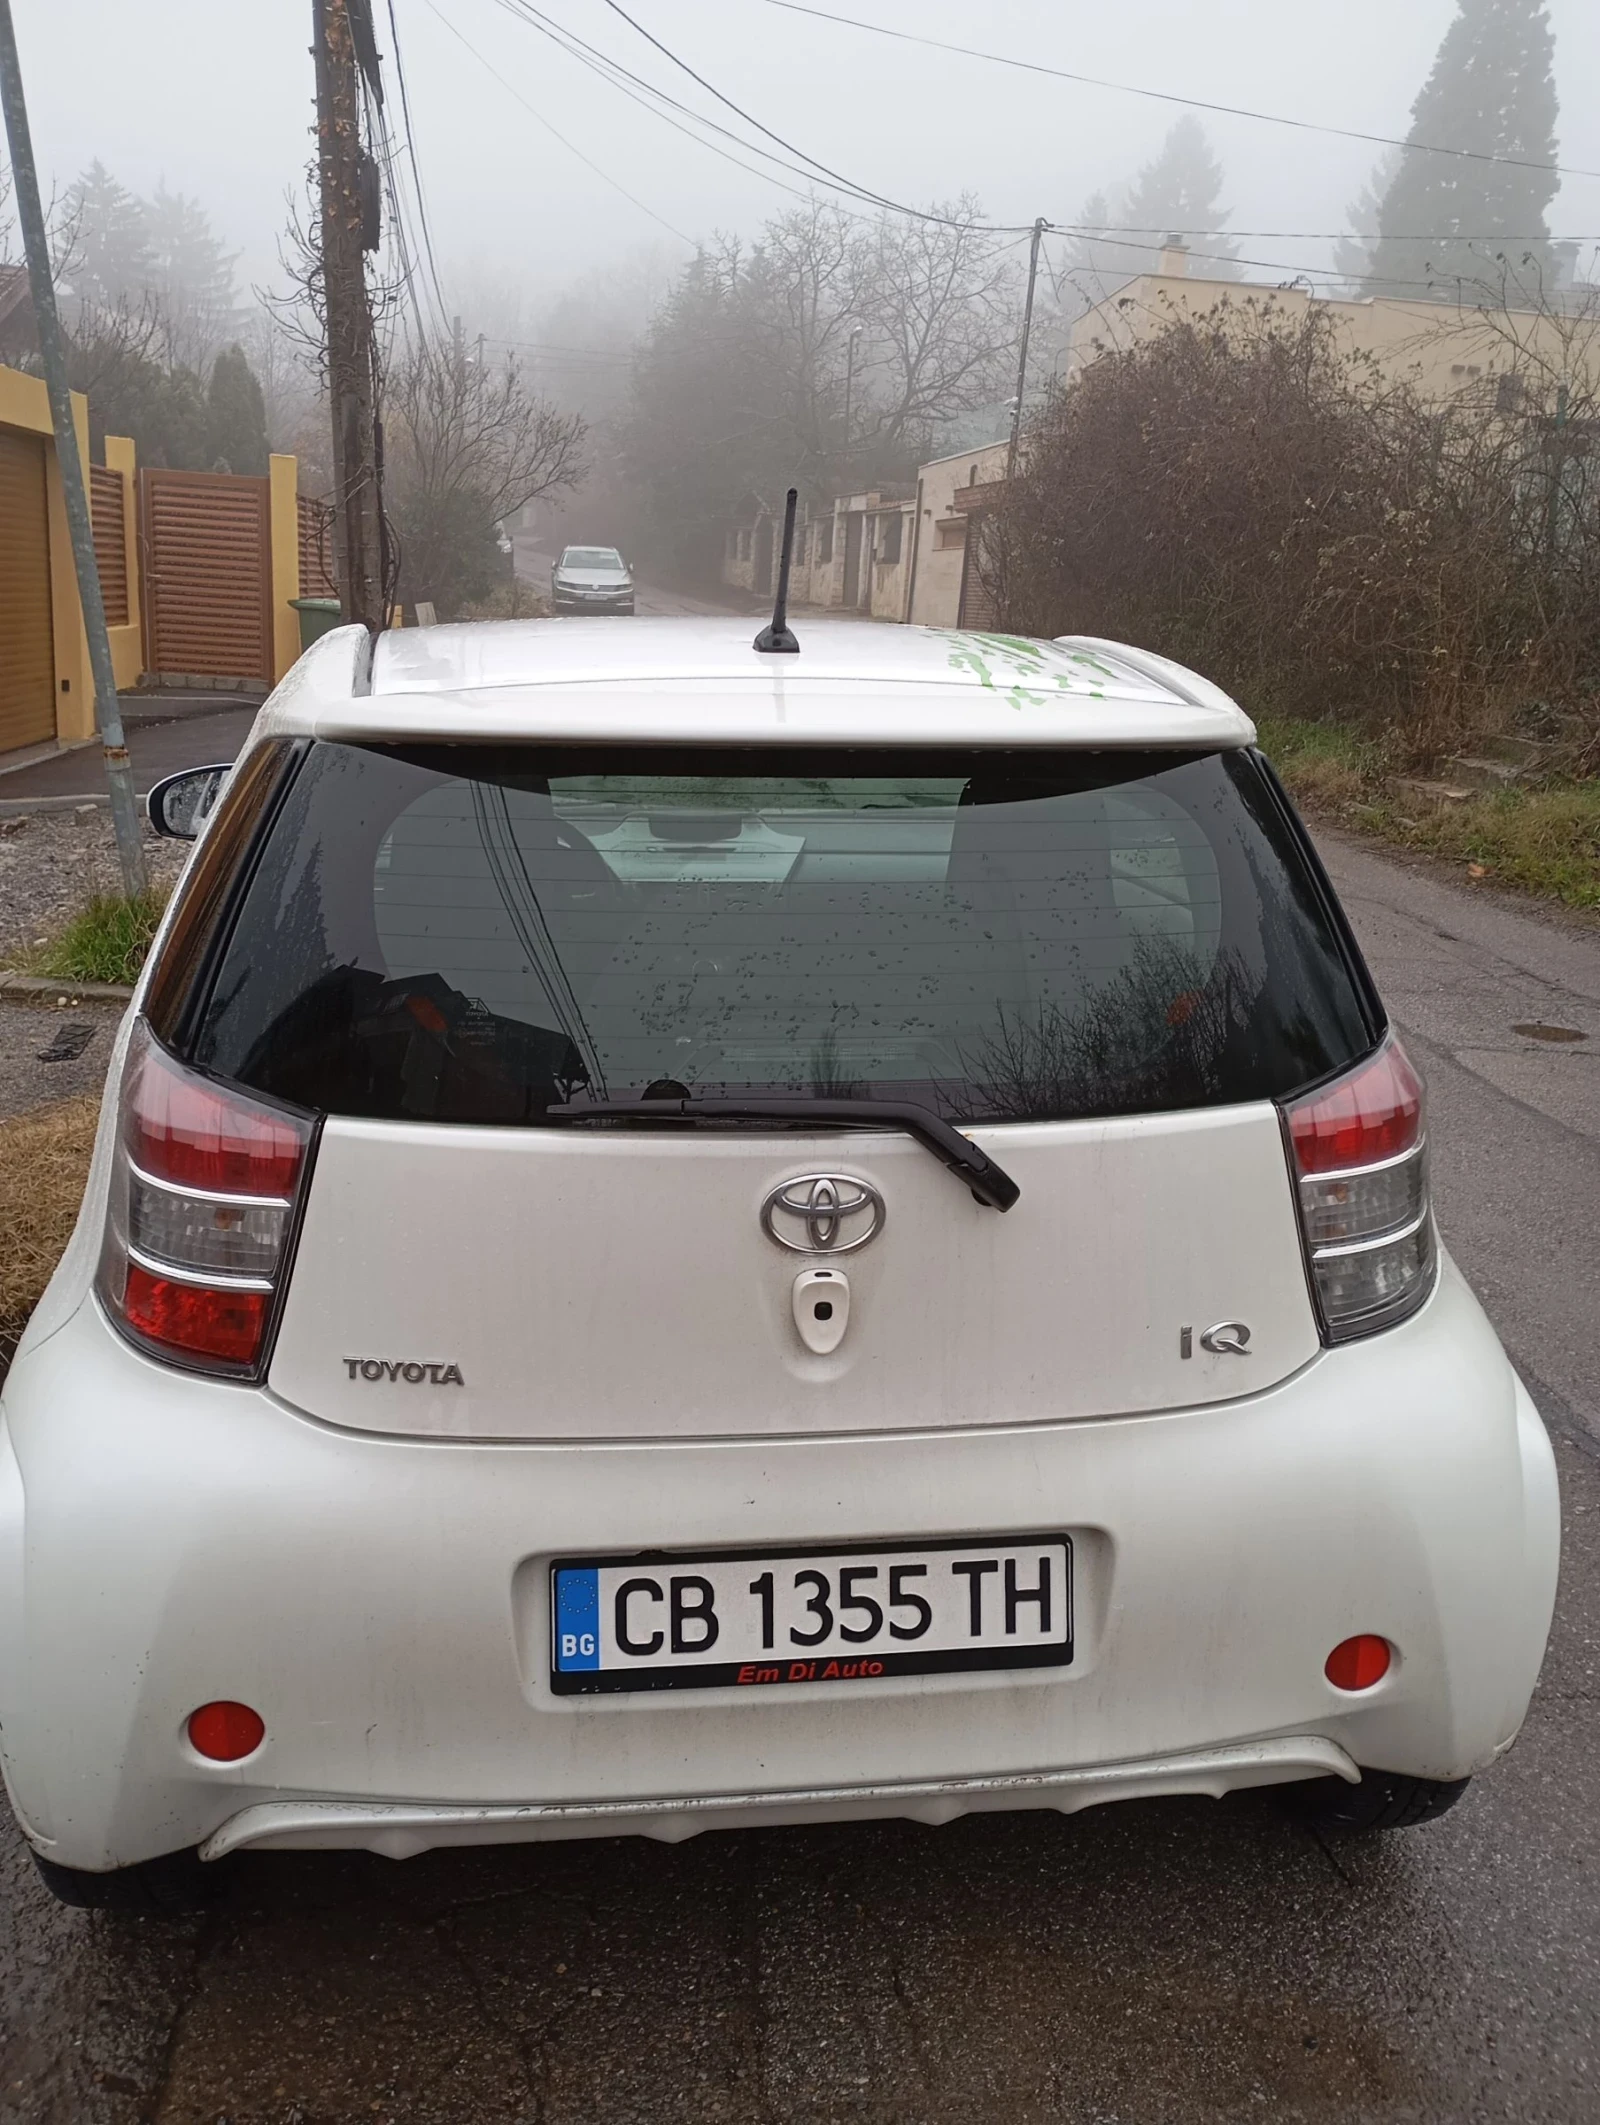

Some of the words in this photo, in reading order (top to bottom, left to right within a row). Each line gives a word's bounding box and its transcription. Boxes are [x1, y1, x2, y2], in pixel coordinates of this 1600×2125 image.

[343, 1356, 465, 1386] TOYOTA
[615, 1576, 719, 1656] CB
[750, 1564, 932, 1648] 1355
[952, 1557, 1051, 1636] TH
[562, 1633, 595, 1657] BG
[737, 1665, 779, 1684] Em
[788, 1662, 816, 1680] Di
[822, 1660, 883, 1678] Auto
